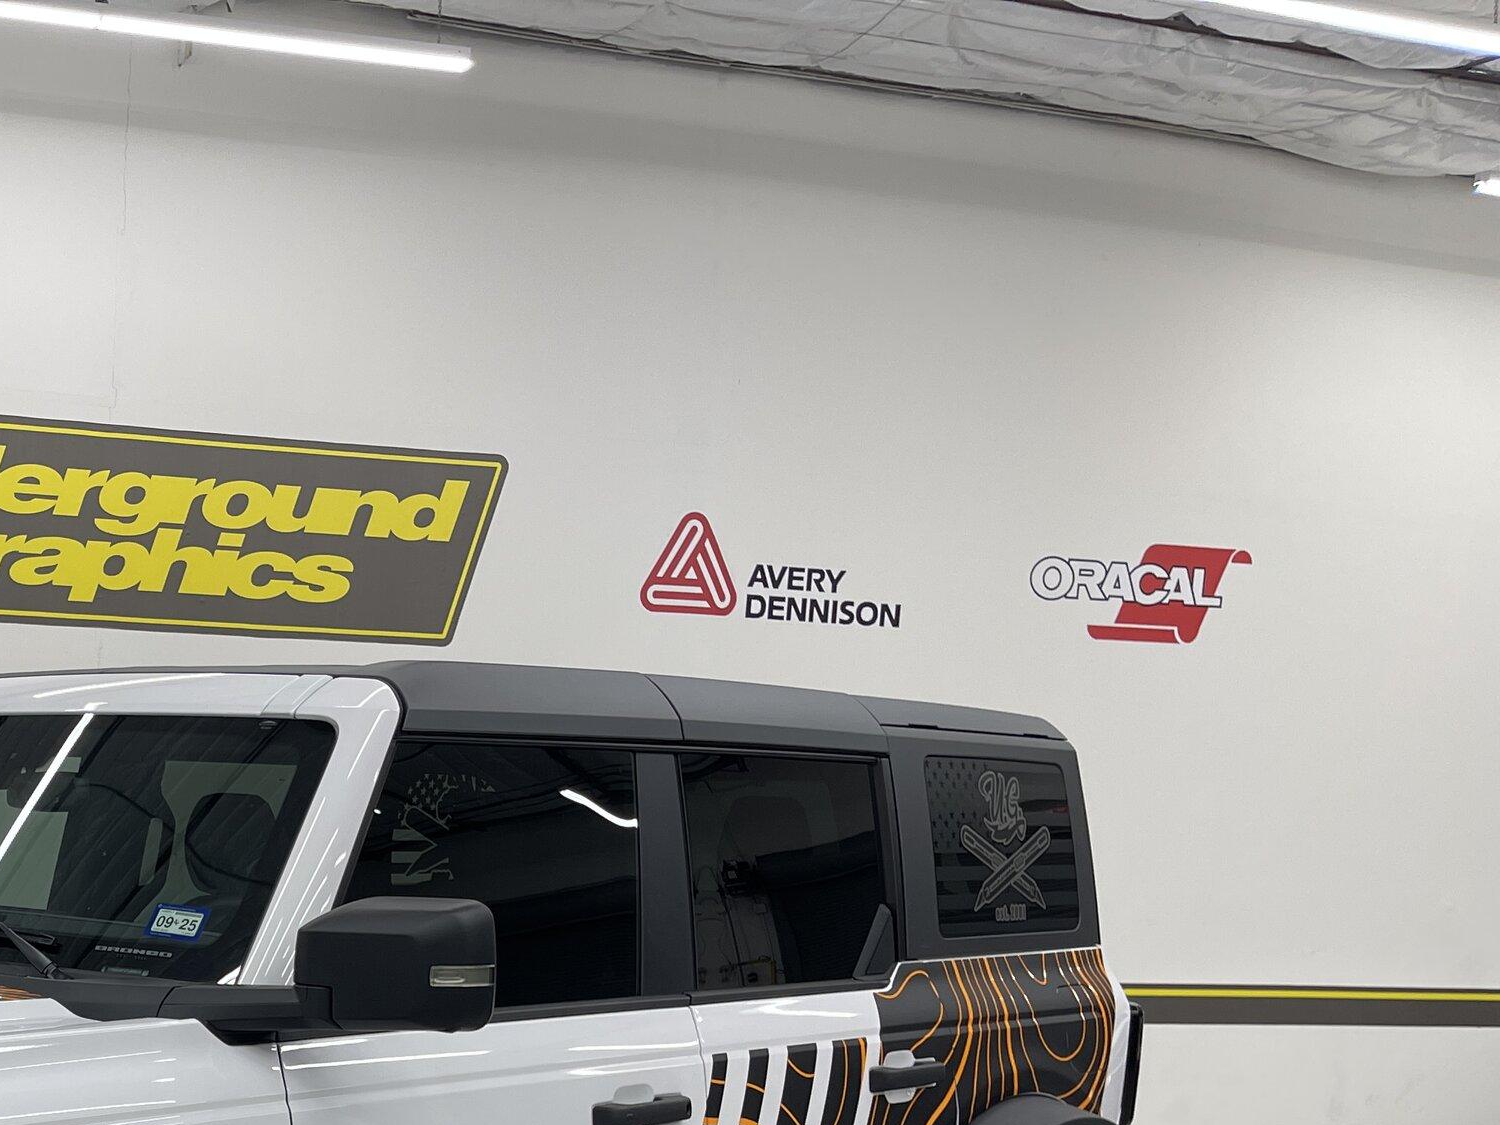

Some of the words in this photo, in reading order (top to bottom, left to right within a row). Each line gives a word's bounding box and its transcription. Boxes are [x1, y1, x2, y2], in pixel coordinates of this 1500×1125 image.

[747, 563, 847, 593] AVERY
[1030, 556, 1223, 608] ORACAL
[745, 594, 901, 628] DENNISON
[156, 915, 175, 928] 09
[178, 918, 198, 932] 25
